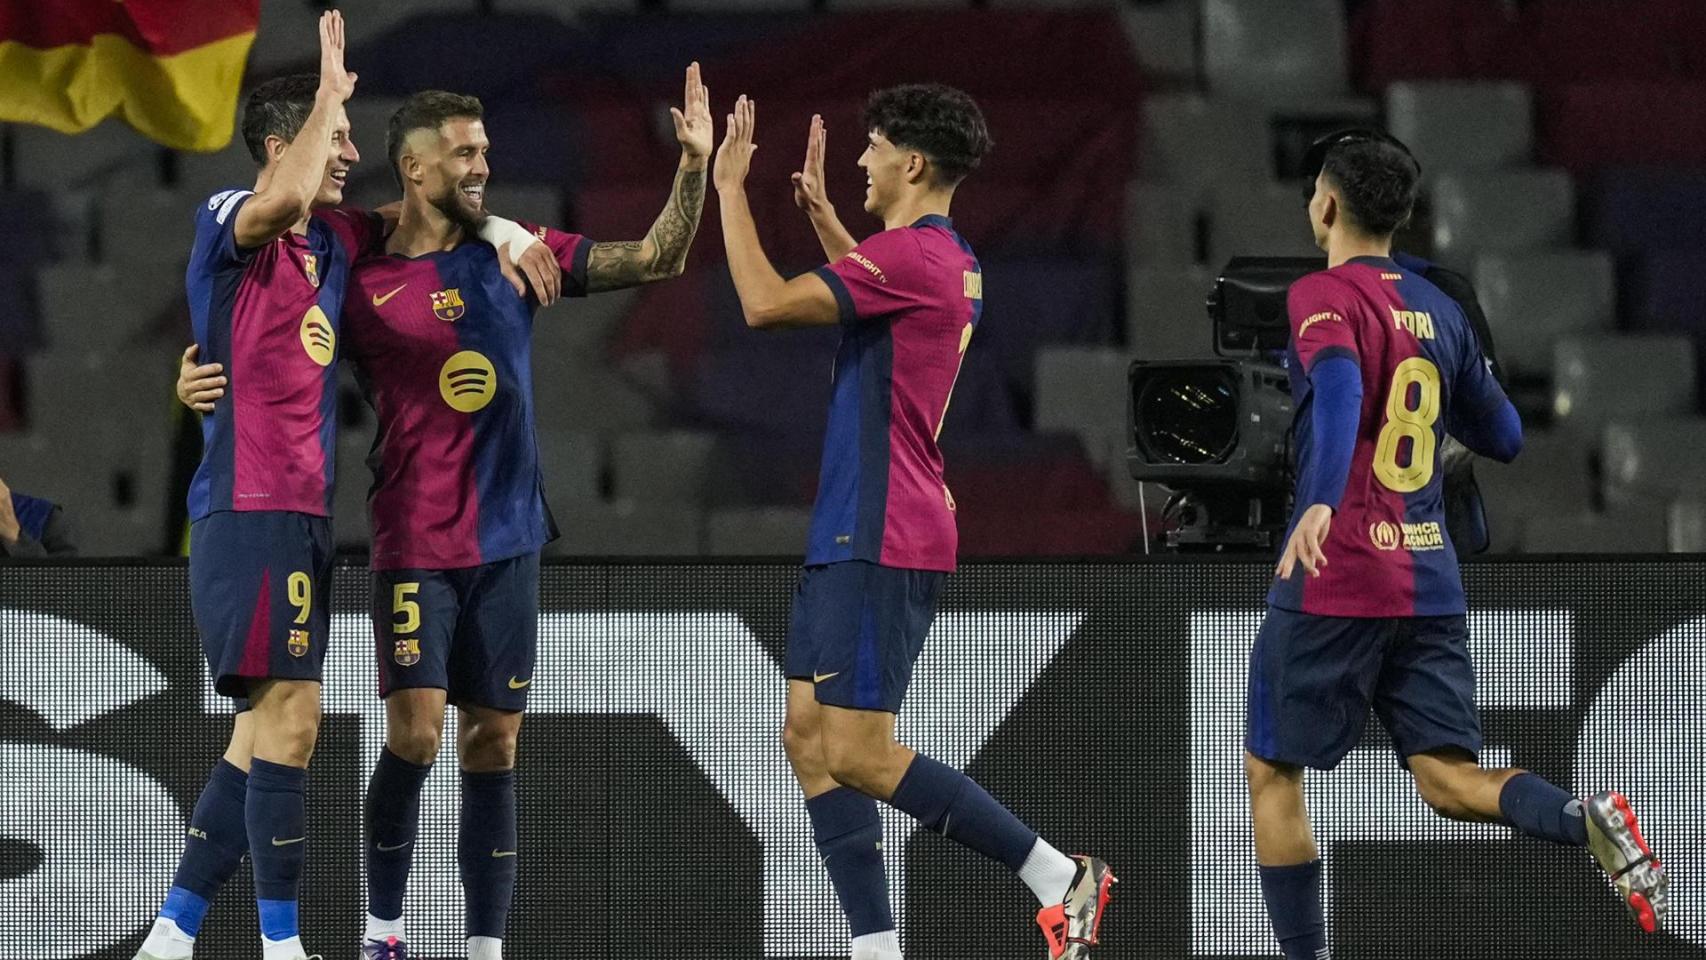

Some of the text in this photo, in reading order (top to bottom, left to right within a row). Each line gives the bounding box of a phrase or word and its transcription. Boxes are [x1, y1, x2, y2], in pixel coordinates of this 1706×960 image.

[1372, 357, 1440, 493] 8
[1400, 522, 1440, 535] UNHCR
[1403, 533, 1443, 546] ACNUR
[288, 571, 311, 624] 9
[393, 582, 421, 634] 5
